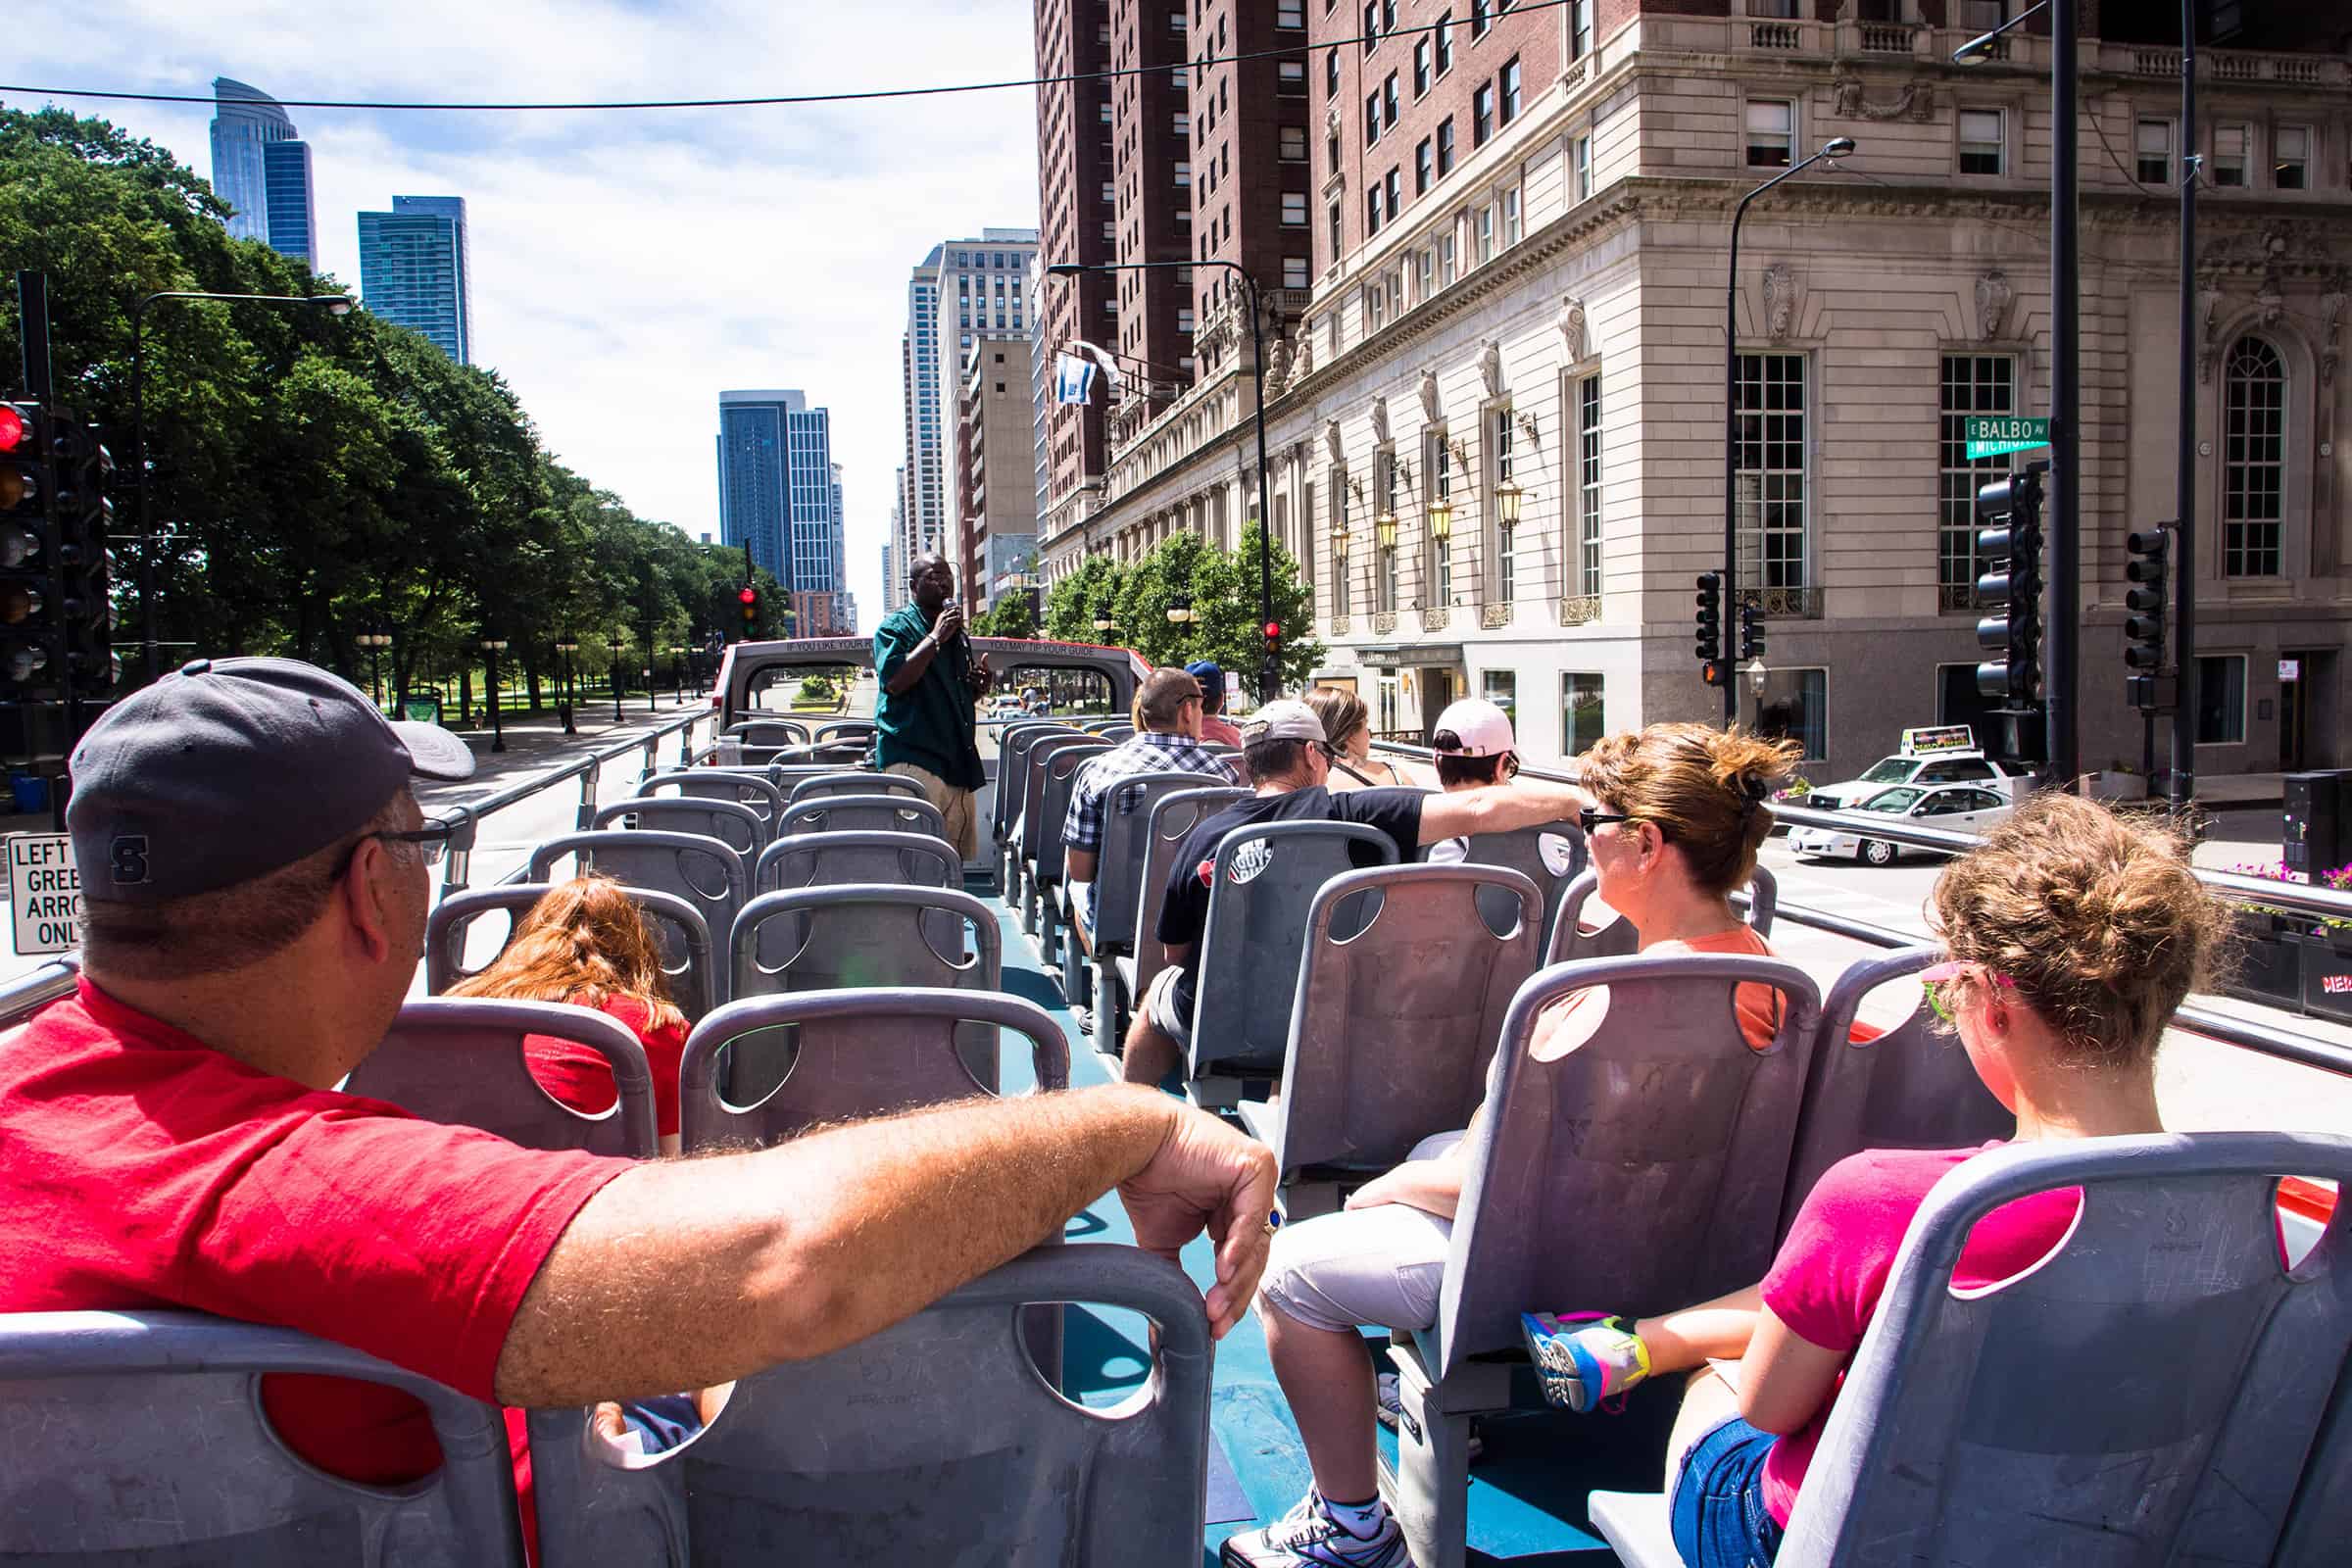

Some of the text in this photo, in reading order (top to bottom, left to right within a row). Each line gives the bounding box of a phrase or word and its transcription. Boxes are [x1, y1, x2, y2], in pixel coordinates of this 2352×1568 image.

[1971, 421, 2045, 439] E BALBO AV
[796, 642, 815, 652] YOU
[815, 641, 838, 651] LIKE
[989, 641, 1095, 657] YOU MAY TIP YOUR GUIDE
[16, 842, 68, 865] LEFT
[1236, 848, 1272, 869] GUYS
[27, 868, 80, 891] GREE
[26, 895, 79, 918] ARRO
[38, 921, 80, 944] ONL
